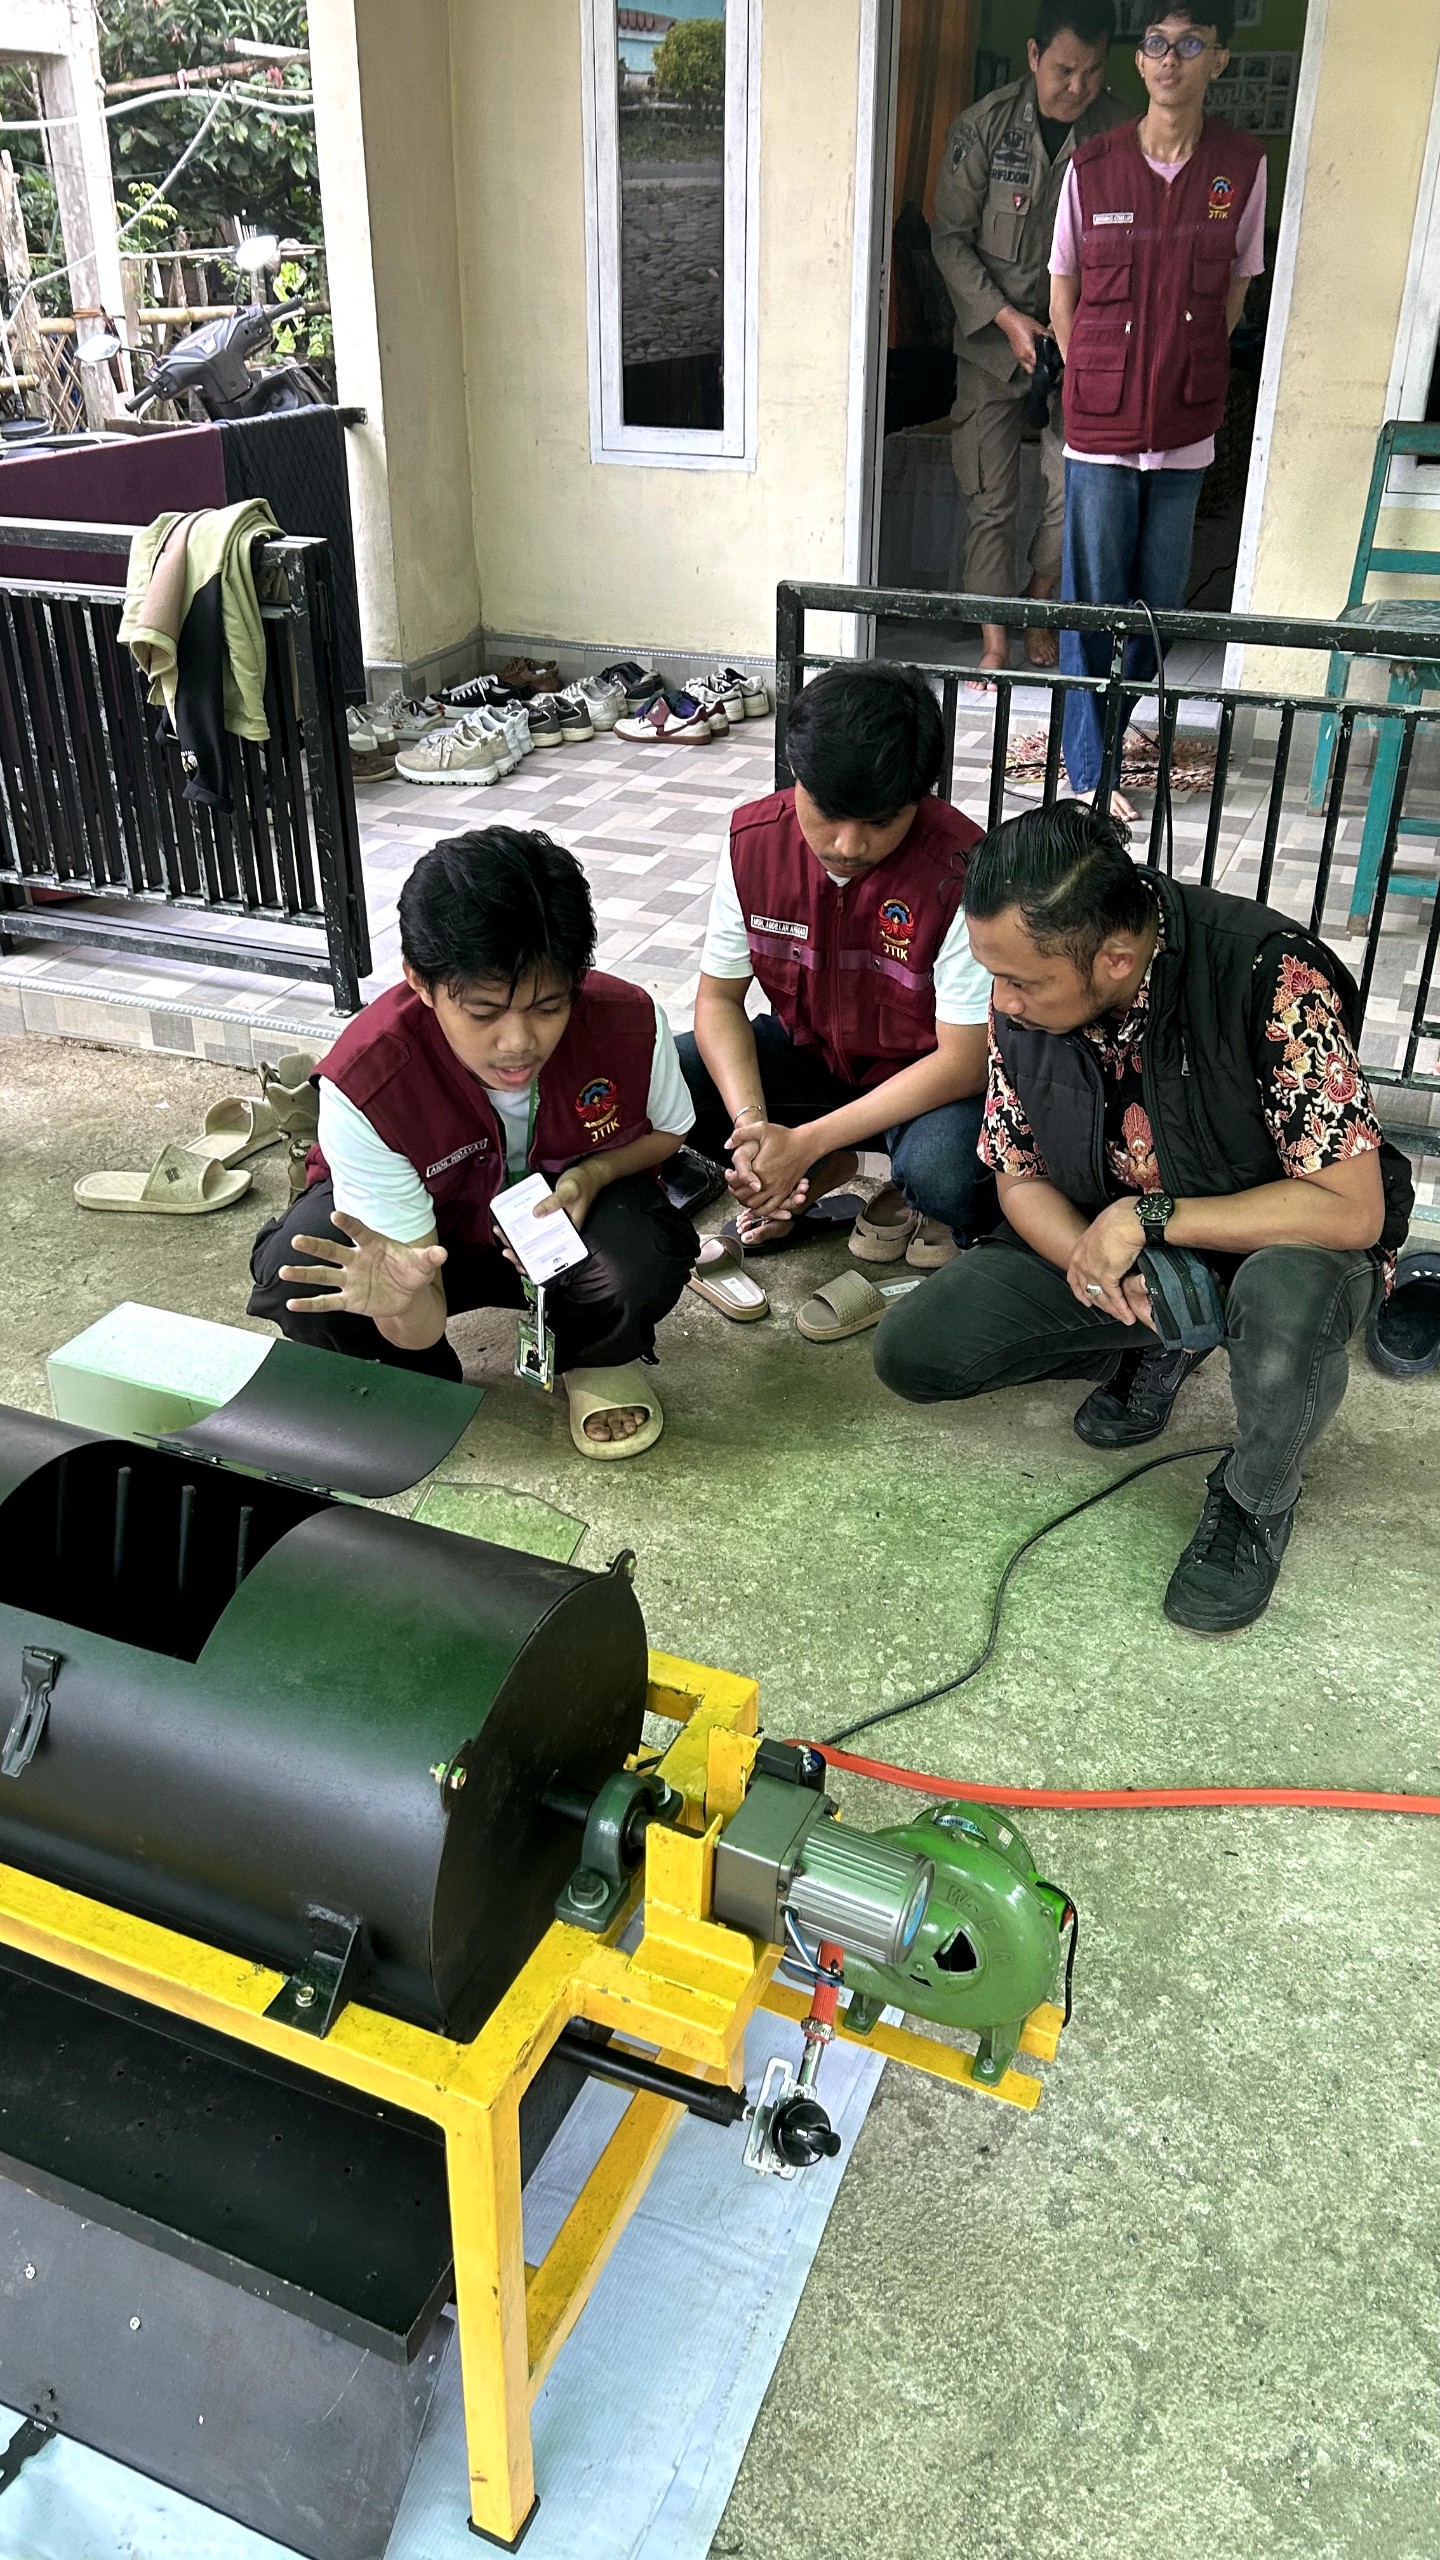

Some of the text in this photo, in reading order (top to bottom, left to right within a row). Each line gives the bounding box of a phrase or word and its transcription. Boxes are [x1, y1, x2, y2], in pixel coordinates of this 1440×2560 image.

[1208, 209, 1228, 219] JTIK
[883, 942, 908, 961] JTIK
[590, 1117, 620, 1142] JTIK
